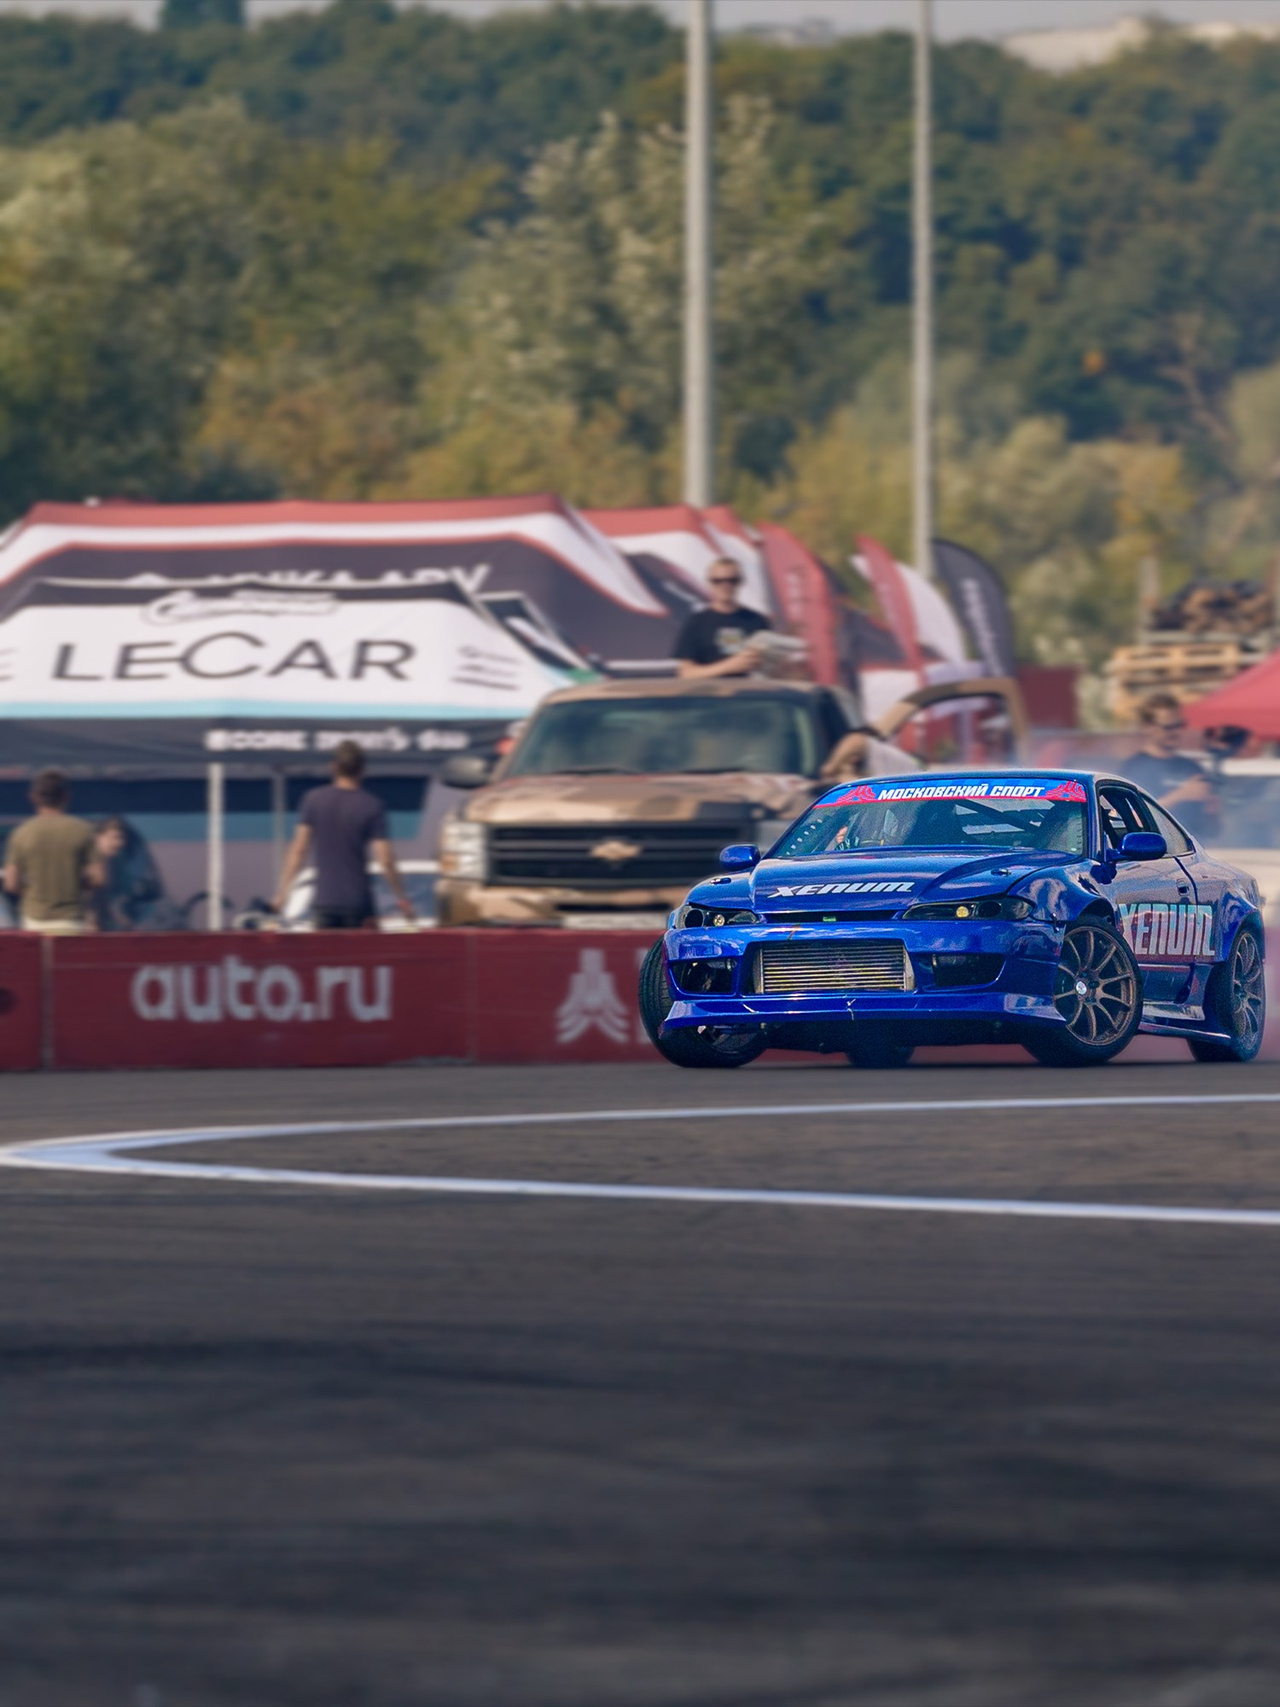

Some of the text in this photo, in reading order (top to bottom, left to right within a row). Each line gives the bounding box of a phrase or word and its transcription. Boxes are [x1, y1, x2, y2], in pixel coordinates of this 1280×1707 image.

[50, 630, 416, 681] LECAR
[877, 783, 1045, 800] МОСКОВСКИЙ СПОРТ
[767, 882, 915, 898] XENUM
[1118, 903, 1216, 956] XENUM
[131, 955, 393, 1022] auto.ru
